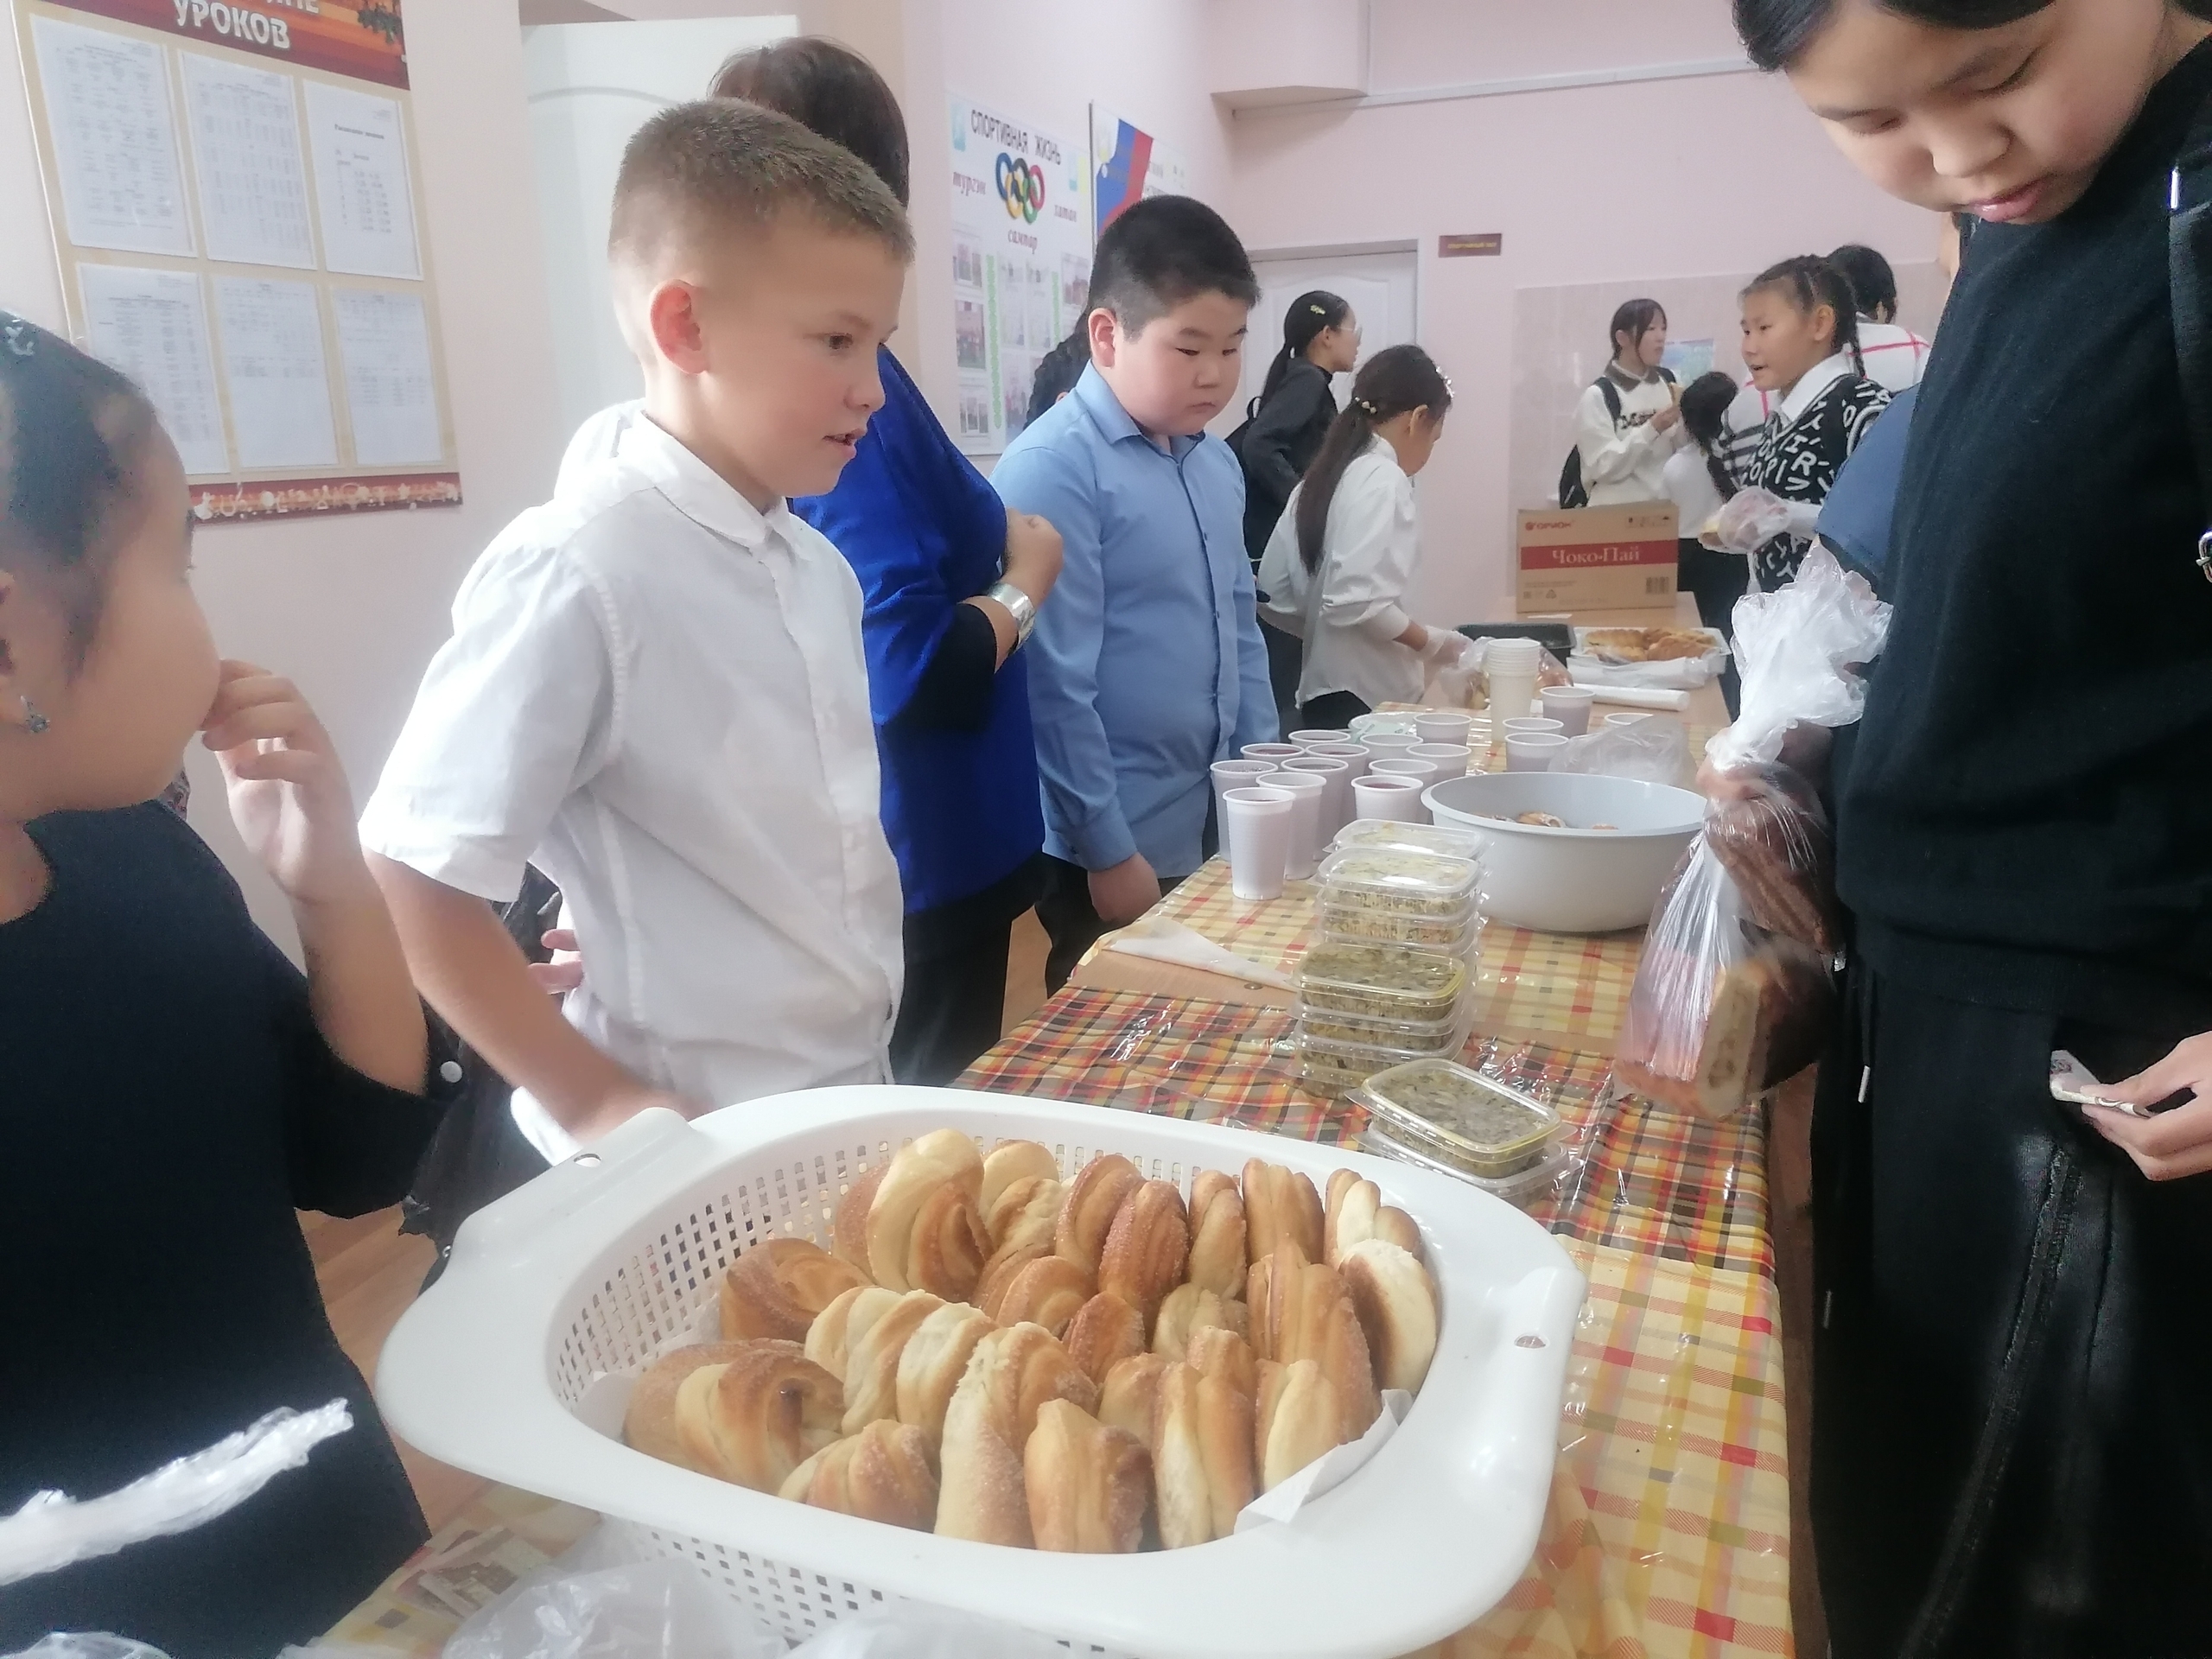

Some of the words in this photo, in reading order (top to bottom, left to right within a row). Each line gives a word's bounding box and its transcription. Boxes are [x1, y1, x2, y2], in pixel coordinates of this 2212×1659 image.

[175, 0, 290, 49] УРОКОВ
[970, 109, 1029, 154] СПОРТИВНАЯ
[1034, 135, 1061, 166] ЖИЗНЬ
[1552, 545, 1640, 565] Чоко-Пай
